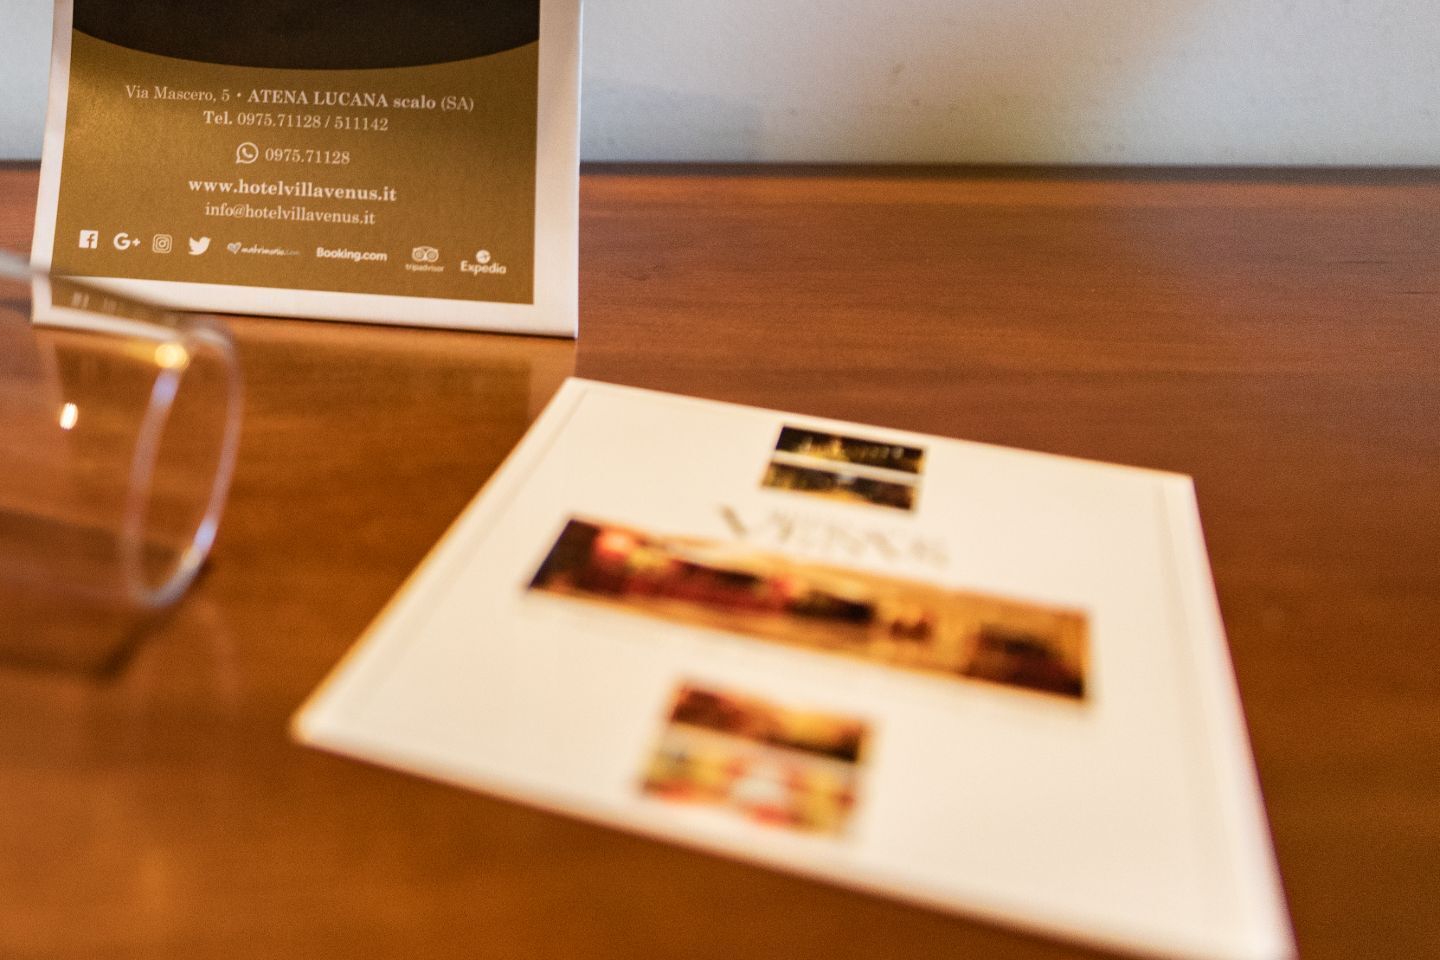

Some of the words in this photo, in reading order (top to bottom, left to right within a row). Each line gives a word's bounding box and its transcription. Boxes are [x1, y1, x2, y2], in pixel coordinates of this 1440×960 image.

[125, 85, 150, 99] Via
[154, 86, 217, 102] Mascero,
[221, 89, 231, 102] 5
[247, 89, 309, 105] ATENA
[313, 91, 389, 108] LUCANA
[392, 95, 437, 110] scalo
[440, 96, 474, 112] (SA)
[203, 111, 233, 125] Tel.
[237, 112, 322, 128] 0975.71128
[334, 116, 389, 132] 511142
[265, 148, 351, 165] 0975.71128
[188, 179, 397, 202] www.hotelvillavenus.it
[205, 202, 376, 225] info@hotelvillavenus.it
[316, 246, 388, 262] Booking.com
[460, 260, 508, 276] Expedia
